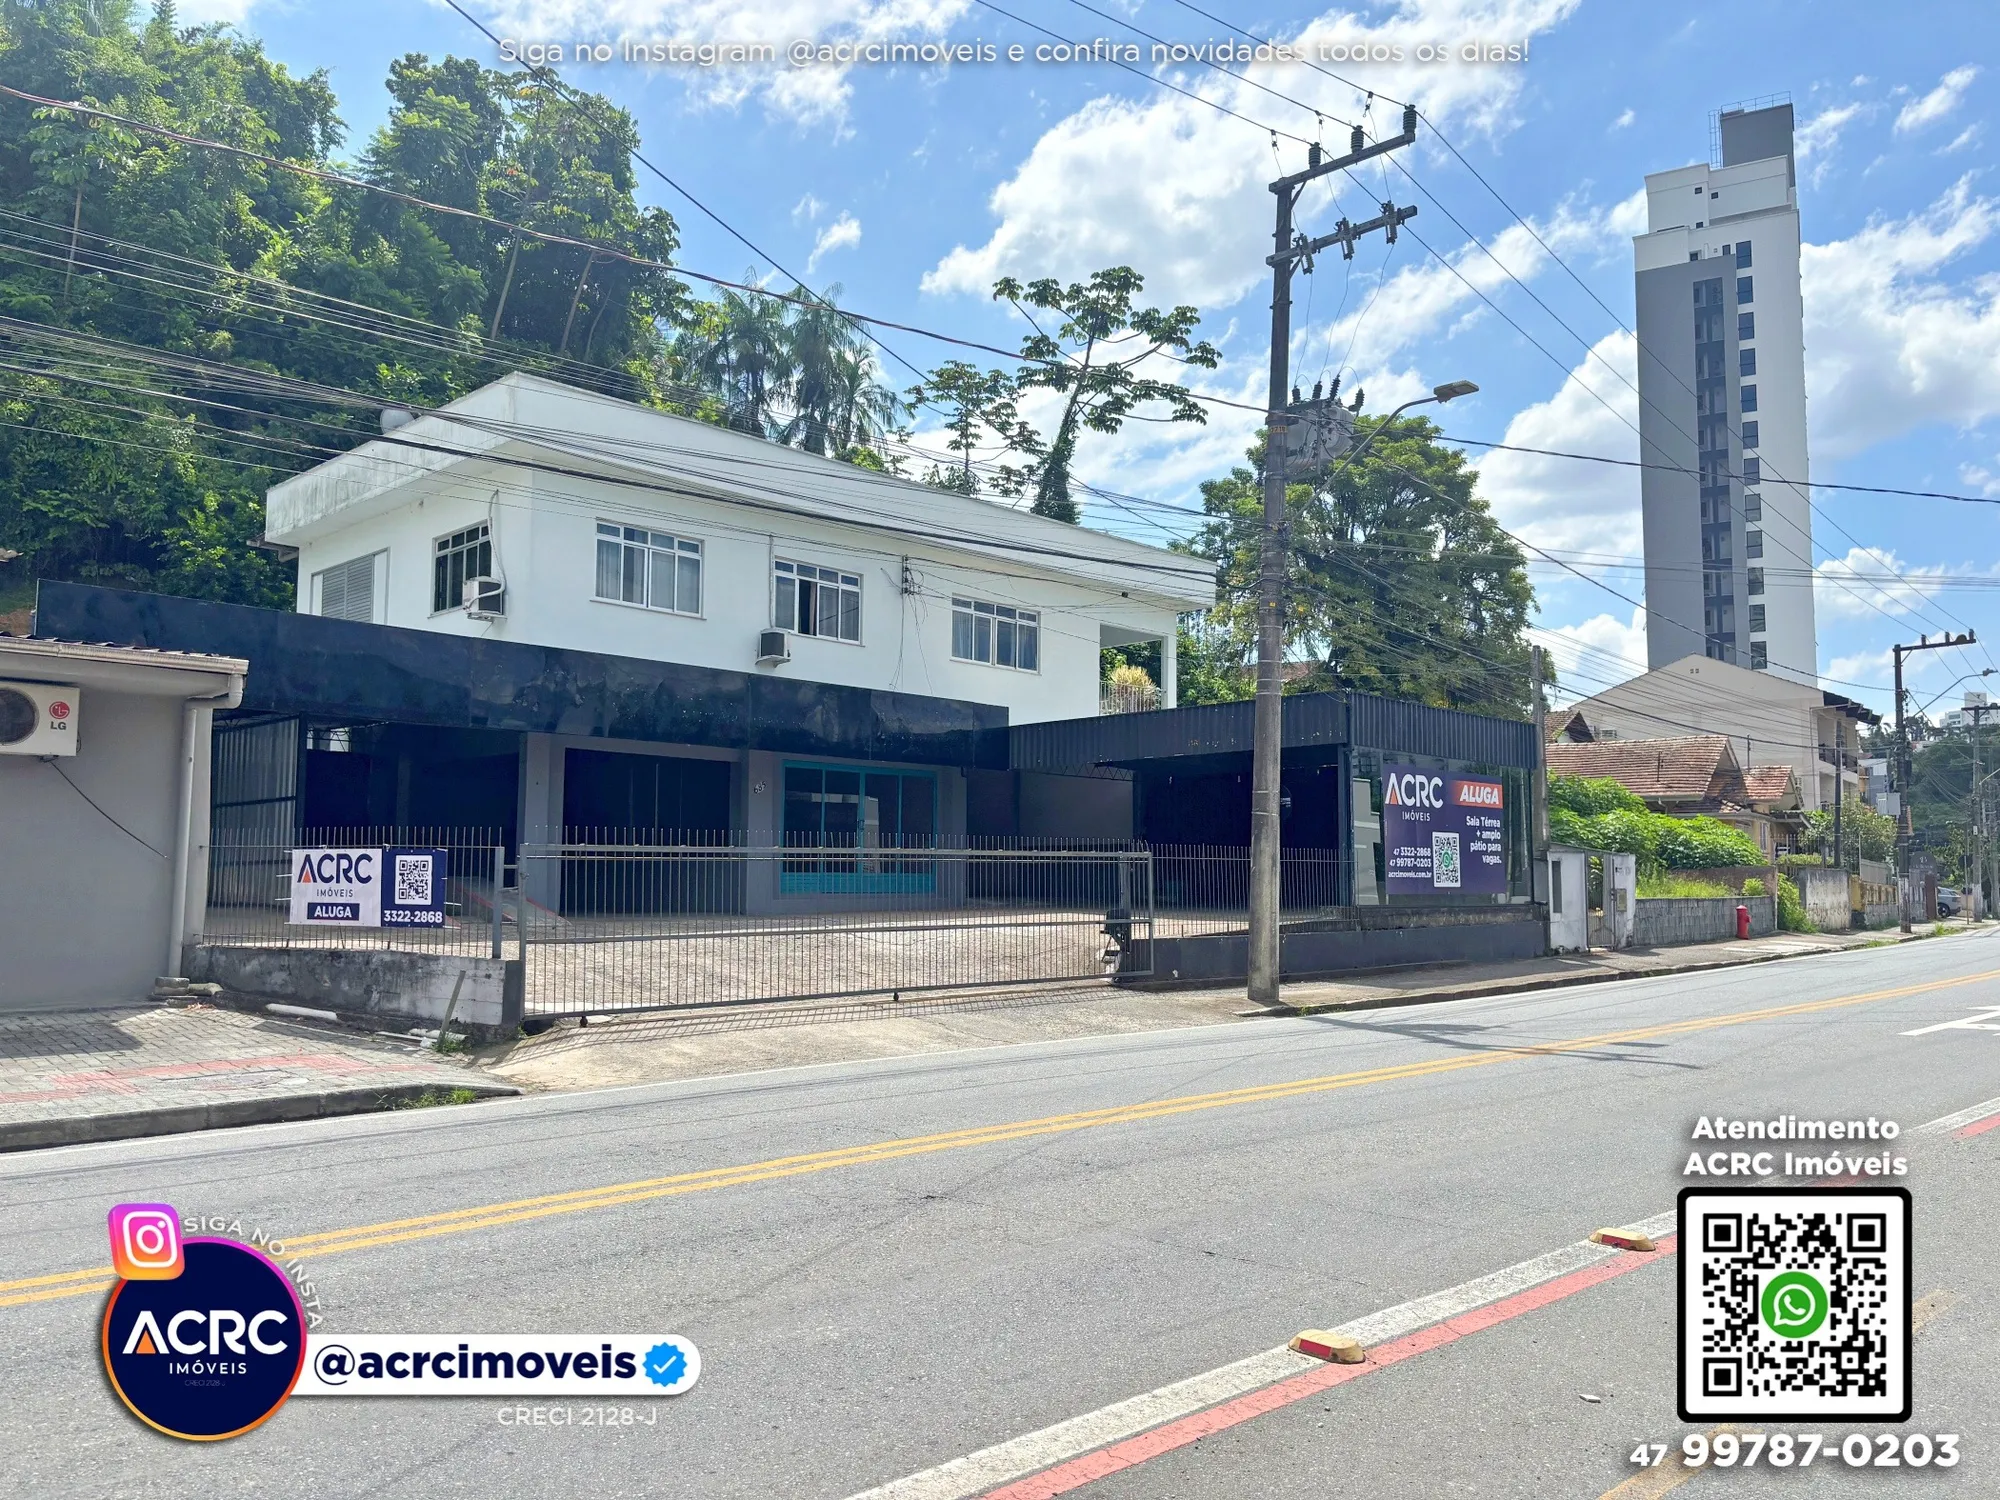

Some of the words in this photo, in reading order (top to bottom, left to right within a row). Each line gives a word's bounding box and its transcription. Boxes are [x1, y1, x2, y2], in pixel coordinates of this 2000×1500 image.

[50, 721, 67, 731] LG
[1385, 772, 1444, 809] ACRC
[1459, 784, 1500, 805] ALUGA
[1401, 809, 1431, 822] IMÓVEIS
[1466, 815, 1480, 826] Sala
[1480, 816, 1501, 828] Térrea
[1476, 829, 1481, 837] +
[1481, 829, 1502, 841] amplo
[1400, 846, 1432, 857] 3322-2868
[1470, 840, 1487, 852] pátio
[1487, 843, 1502, 853] para
[1396, 857, 1432, 868] 99787-0203
[1482, 854, 1502, 866] vagas.
[297, 853, 373, 884] ACRC
[316, 887, 354, 898] IMÓVEIS
[314, 905, 353, 918] ALUGA
[383, 909, 443, 924] 3322-2868
